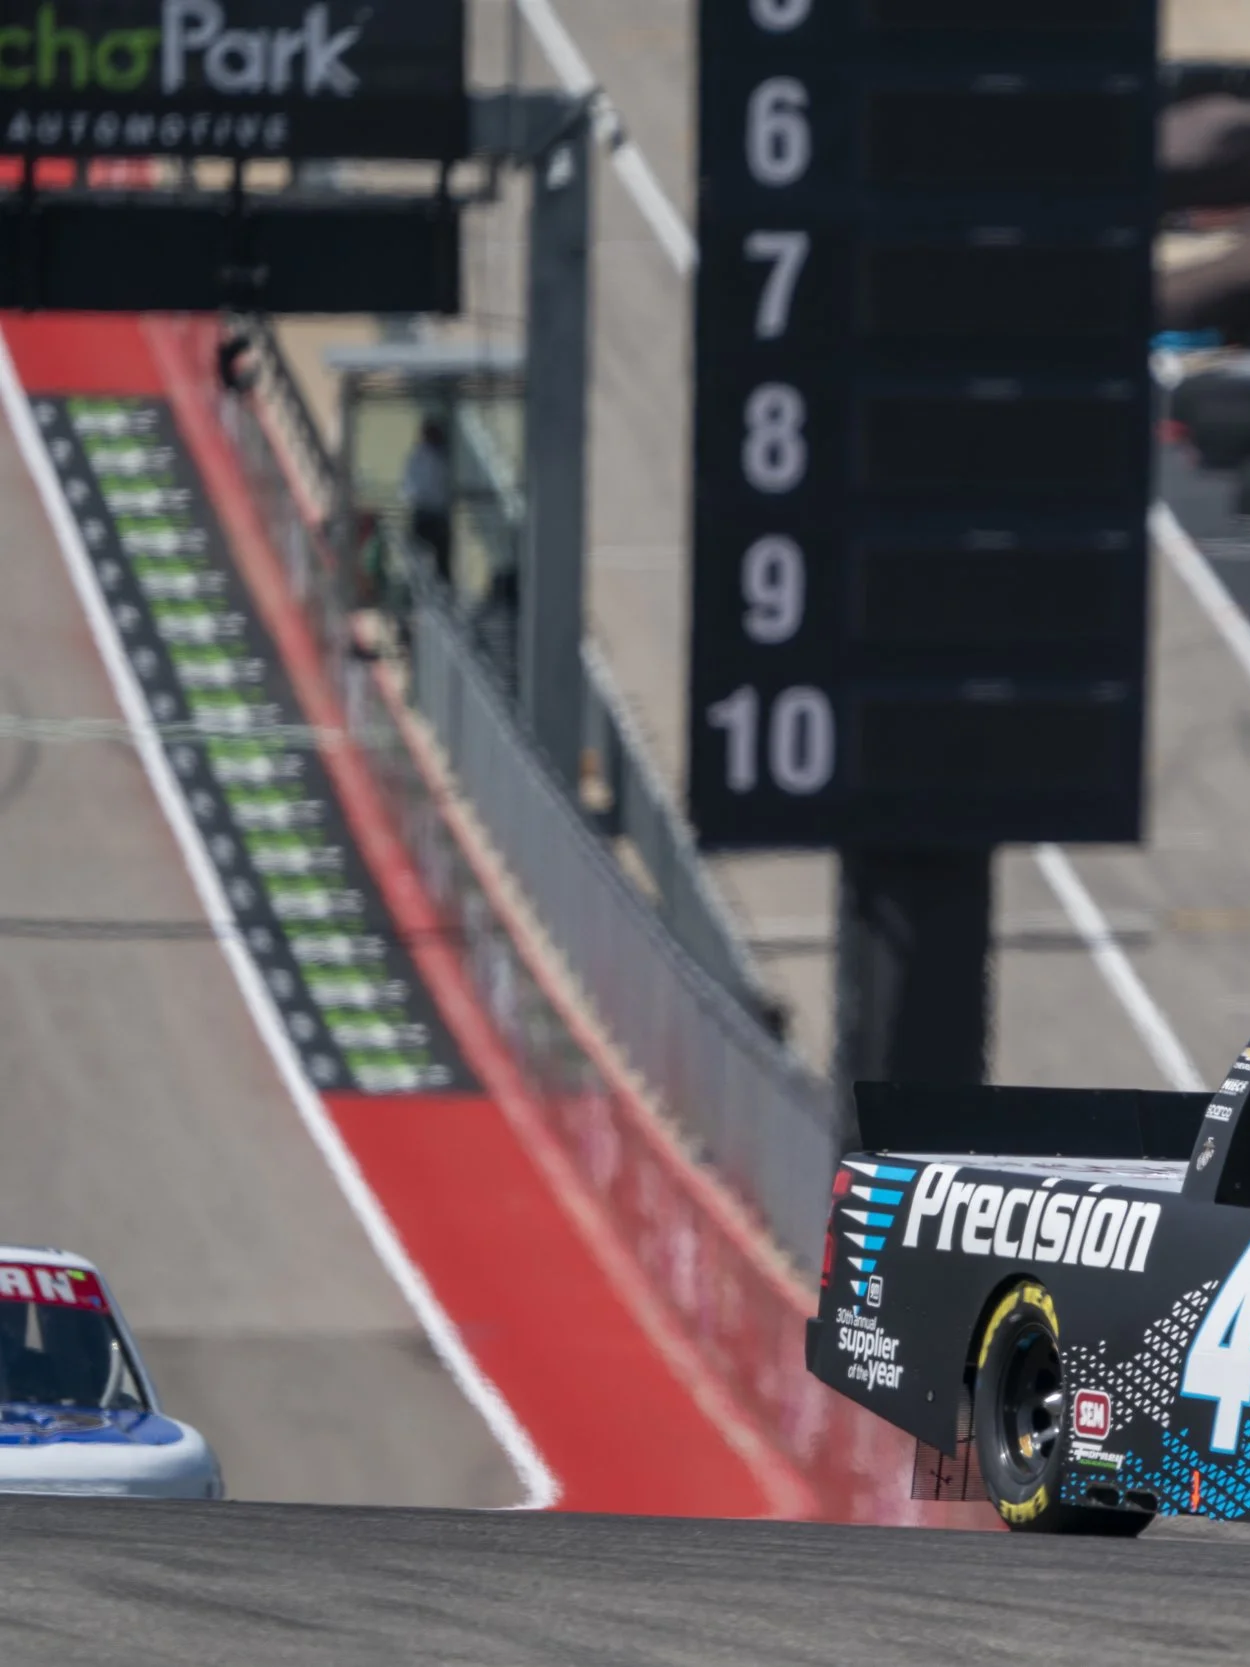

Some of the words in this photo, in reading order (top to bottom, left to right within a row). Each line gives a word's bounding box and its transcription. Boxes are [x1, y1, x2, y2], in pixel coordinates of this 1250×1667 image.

[6, 110, 288, 147] AUTOMOTIVE
[745, 74, 812, 188] 6
[743, 230, 810, 340] 7
[741, 380, 807, 494] 8
[740, 532, 806, 645] 9
[705, 683, 836, 795] 10
[902, 1162, 1162, 1273] Precision
[836, 1307, 854, 1326] 30th
[853, 1315, 878, 1331] annual
[838, 1326, 900, 1362] supplier
[847, 1363, 857, 1378] of
[867, 1359, 904, 1392] year
